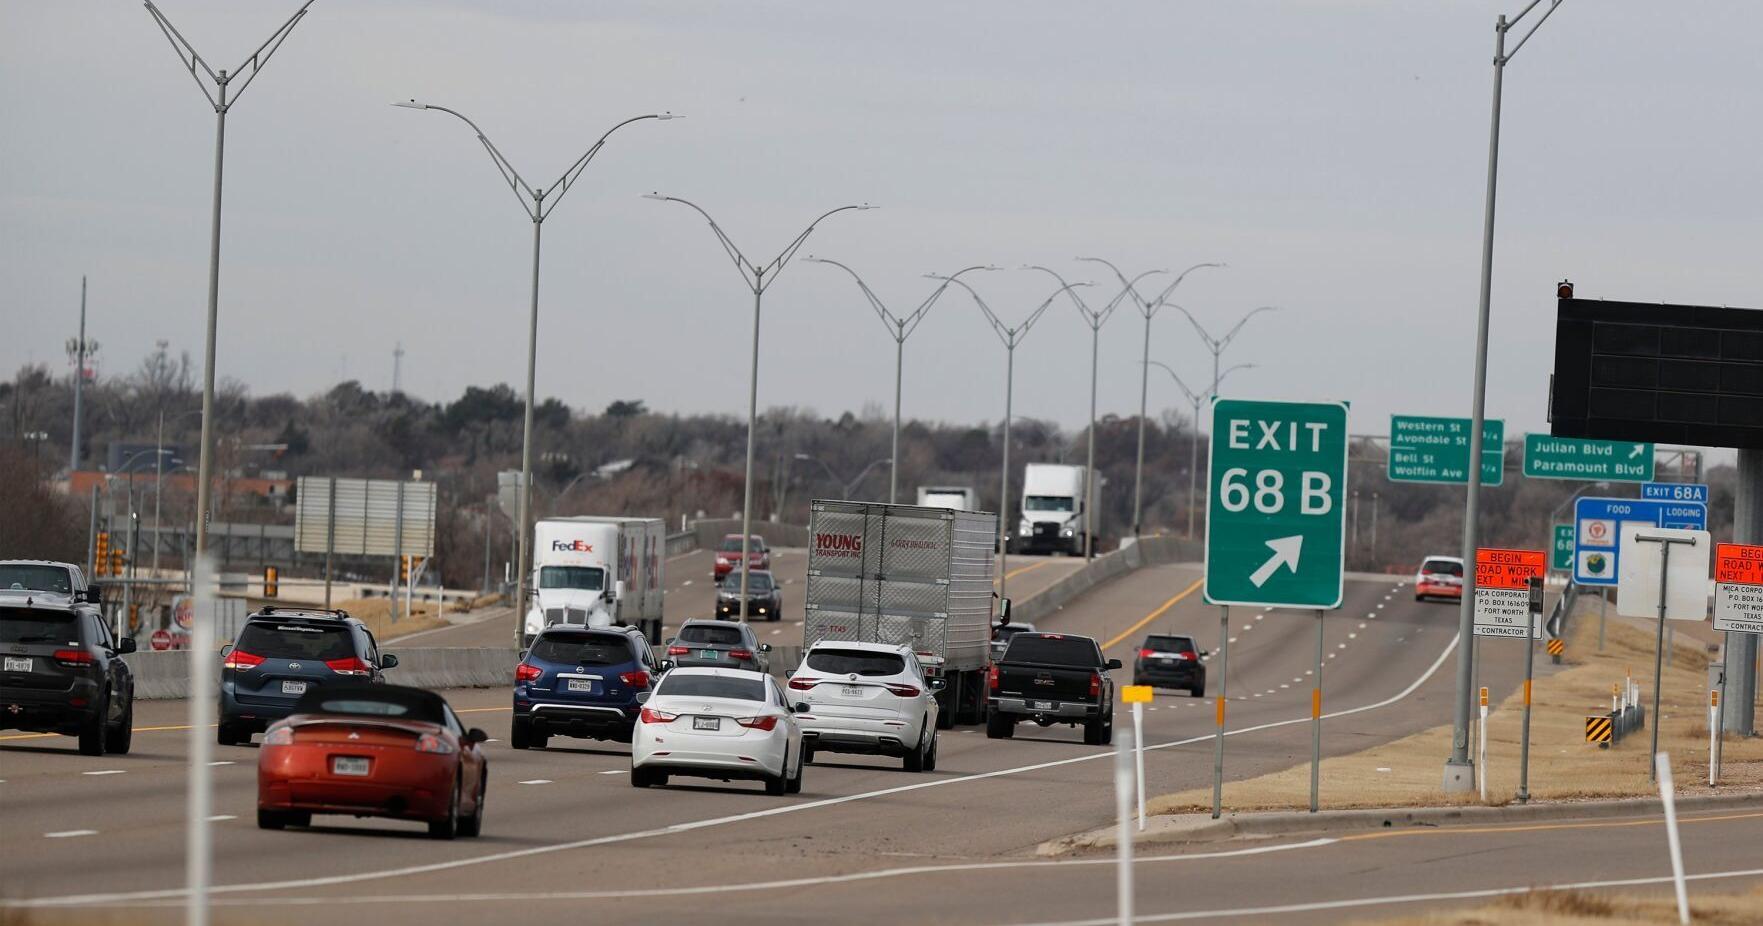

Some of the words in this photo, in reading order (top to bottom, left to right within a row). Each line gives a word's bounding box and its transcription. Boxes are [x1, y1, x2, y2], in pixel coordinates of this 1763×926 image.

[1397, 421, 1444, 432] Western
[1450, 423, 1461, 432] St
[1229, 419, 1328, 452] EXIT
[1397, 434, 1450, 445] Avondale
[1456, 436, 1467, 446] St
[1535, 442, 1576, 454] Julian
[1583, 444, 1613, 456] Blvd
[1395, 453, 1417, 463] Bell
[1423, 454, 1434, 464] St
[1395, 467, 1436, 476] Wolflin
[1442, 468, 1463, 478] Ave
[1533, 460, 1608, 473] Paramount
[1615, 464, 1645, 476] Blvd
[1220, 468, 1285, 514] 68
[1301, 471, 1333, 515] B
[1646, 487, 1670, 497] EXIT
[1673, 487, 1702, 500] 68A
[1607, 505, 1631, 514] FOOD
[1666, 507, 1701, 517] LODGING
[552, 540, 593, 552] FedEx
[816, 533, 861, 551] YOUNG
[1557, 540, 1573, 550] 68
[815, 549, 849, 558] TRANSPORT
[851, 551, 861, 559] INC
[1491, 553, 1521, 563] BEGIN
[1741, 549, 1763, 558] BEG
[1724, 560, 1752, 570] ROAD
[1508, 566, 1536, 576] WORK
[1721, 571, 1743, 580] NEXT
[1751, 573, 1754, 581] 1
[1477, 575, 1493, 585] EXT
[1501, 577, 1504, 585] 1
[1512, 578, 1528, 587] MIL
[1482, 628, 1524, 636] CONTRACTOR
